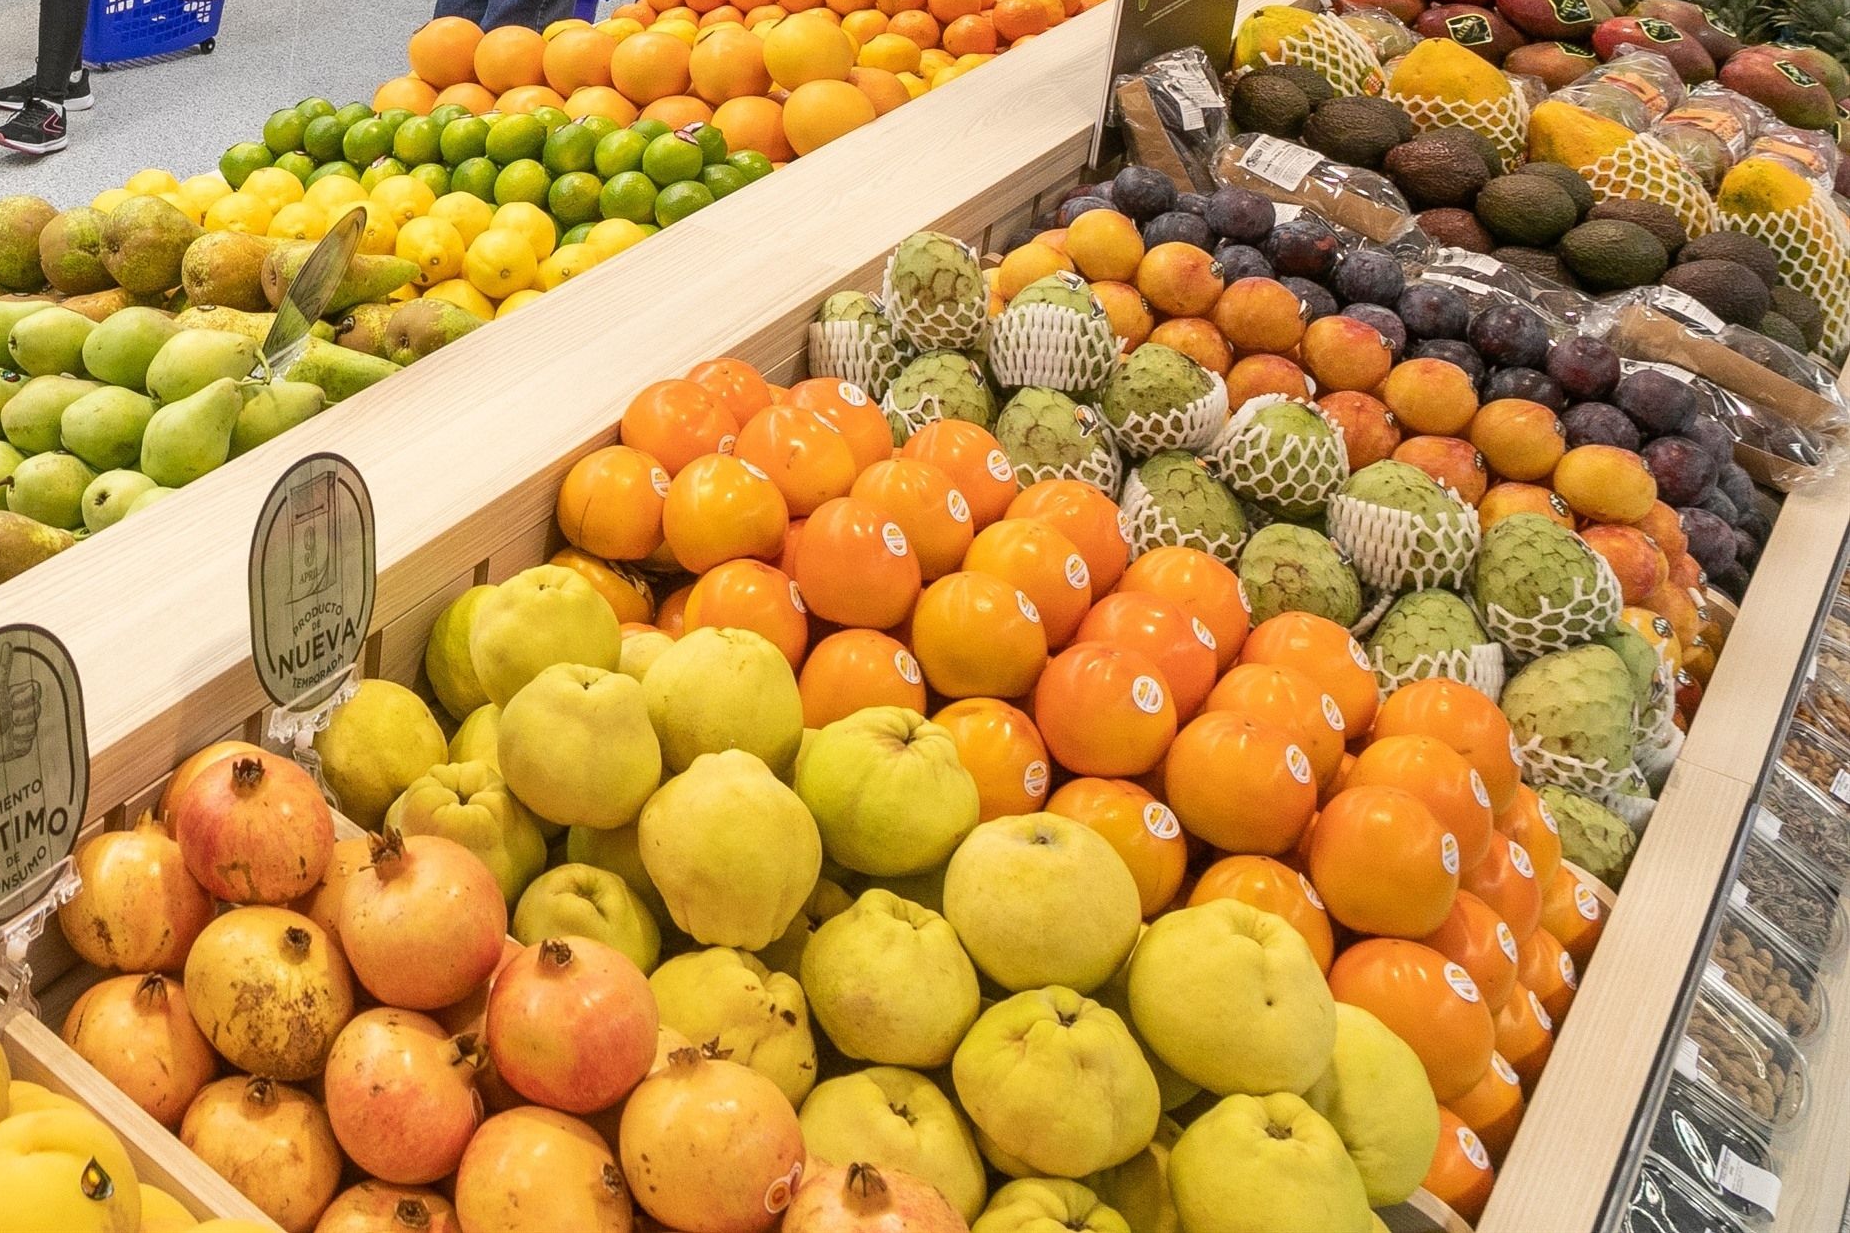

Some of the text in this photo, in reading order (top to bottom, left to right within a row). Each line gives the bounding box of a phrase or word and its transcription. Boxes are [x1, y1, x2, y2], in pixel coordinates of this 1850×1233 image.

[292, 602, 343, 638] PRODUCTO
[311, 619, 322, 632] DE
[278, 616, 357, 680] NUEVA
[292, 653, 344, 690] TEMPORADA
[6, 851, 22, 869] DE
